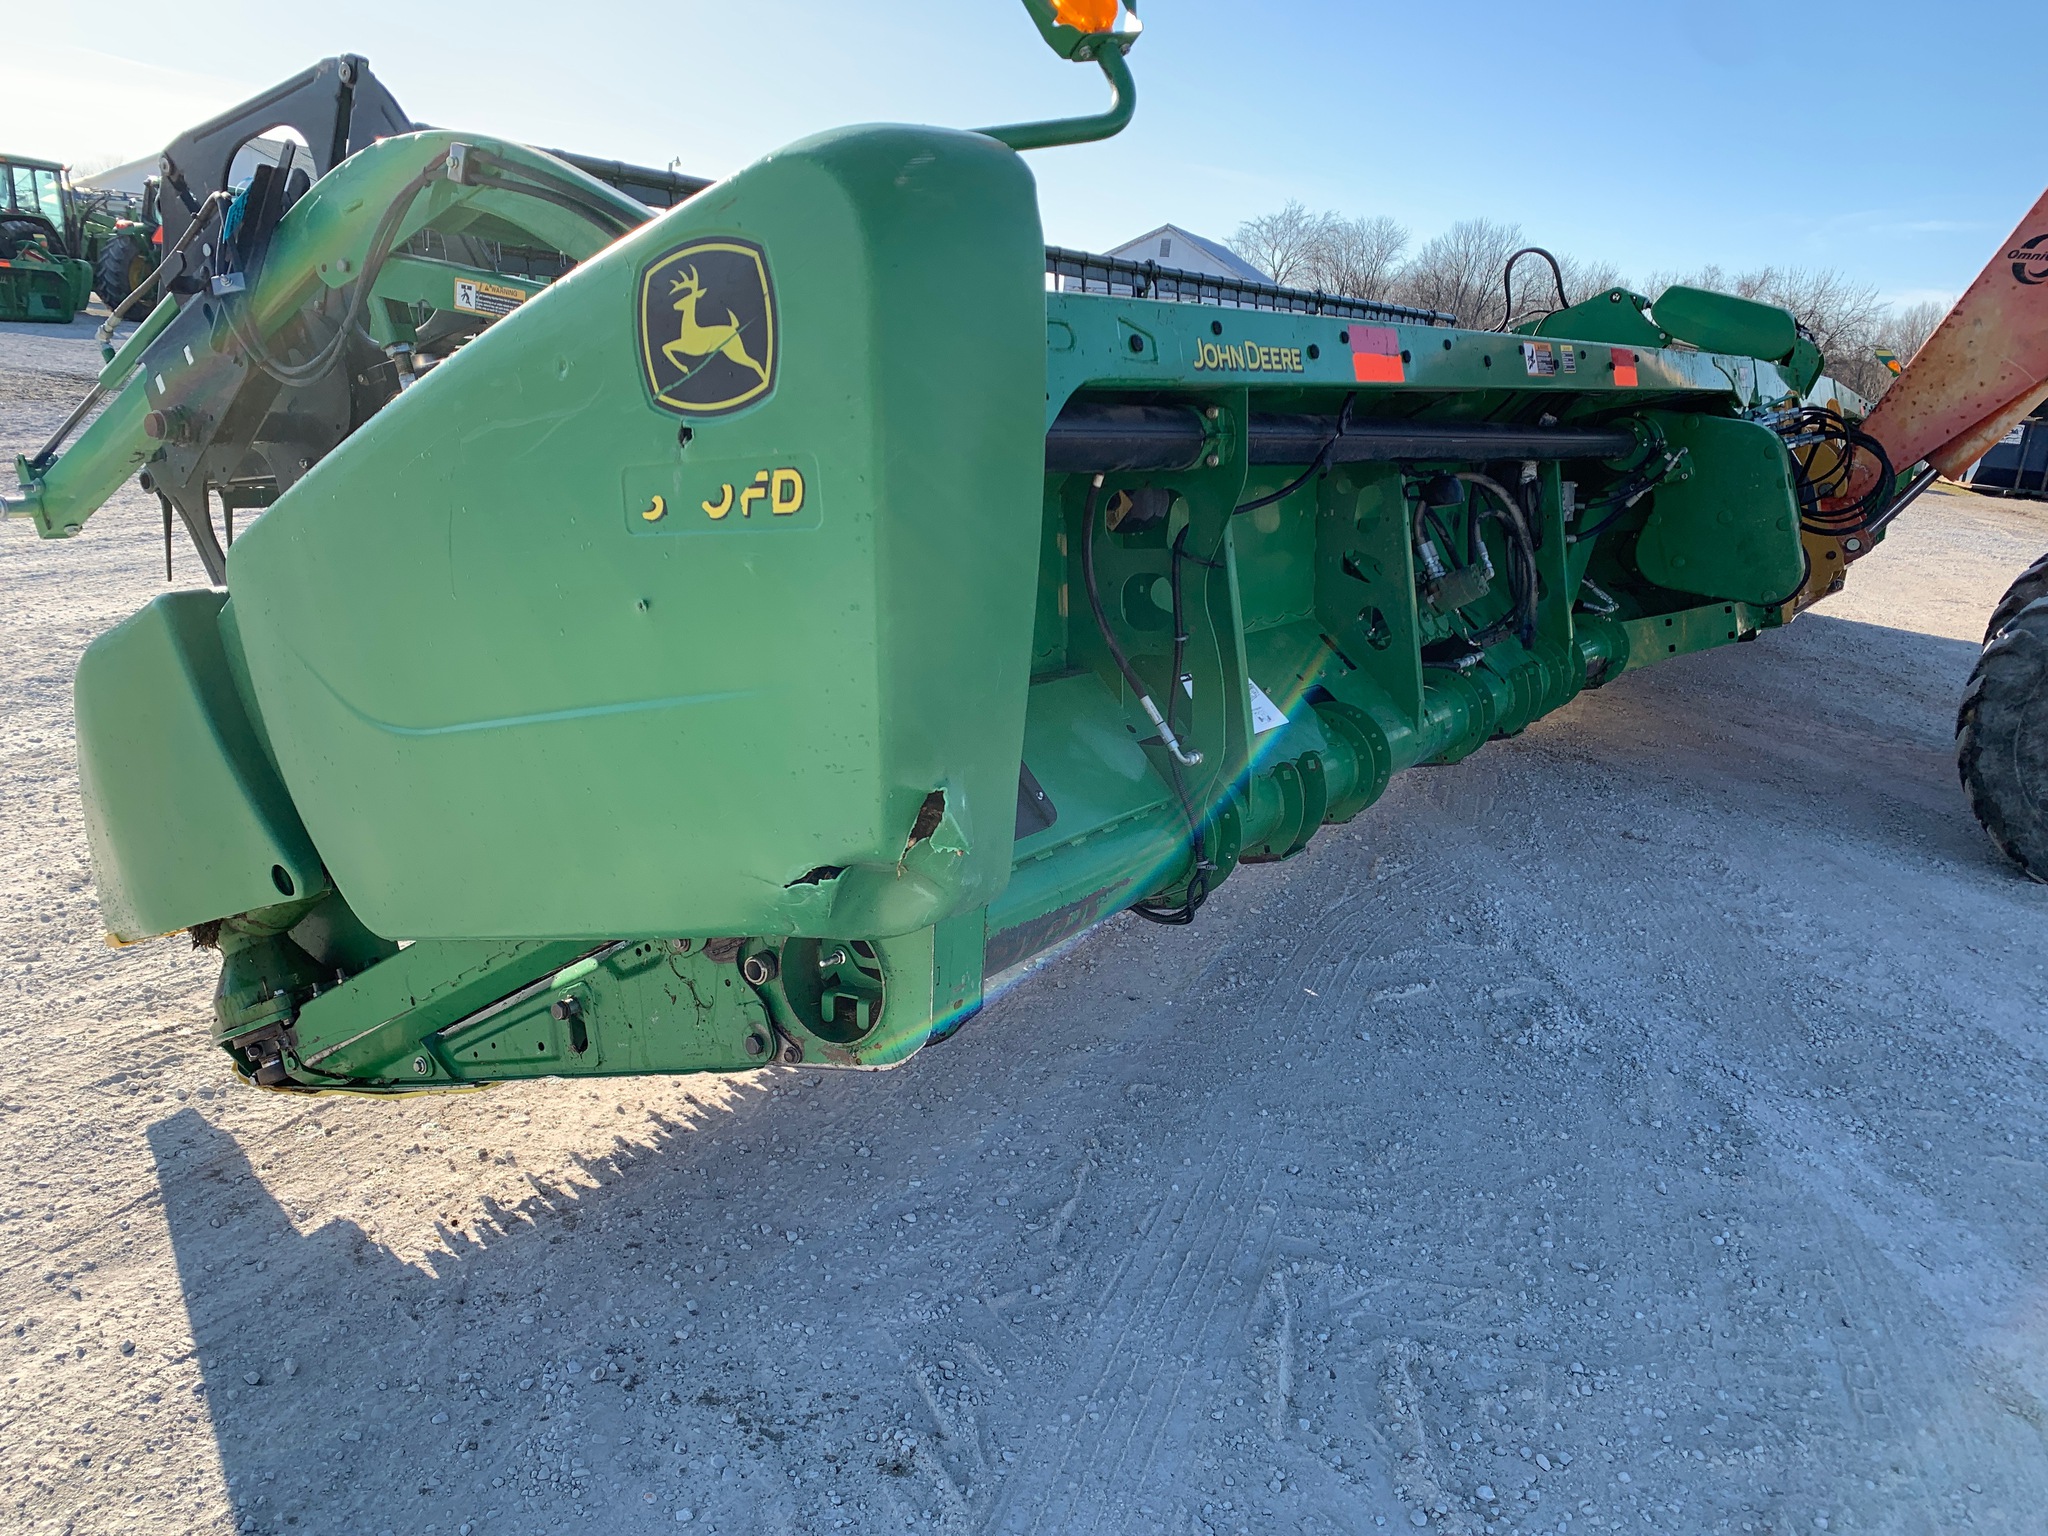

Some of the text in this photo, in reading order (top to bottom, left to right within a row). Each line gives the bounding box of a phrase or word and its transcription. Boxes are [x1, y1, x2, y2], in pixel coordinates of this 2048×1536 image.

[491, 286, 518, 298] WARNING
[1194, 337, 1304, 373] JOHN DEERE
